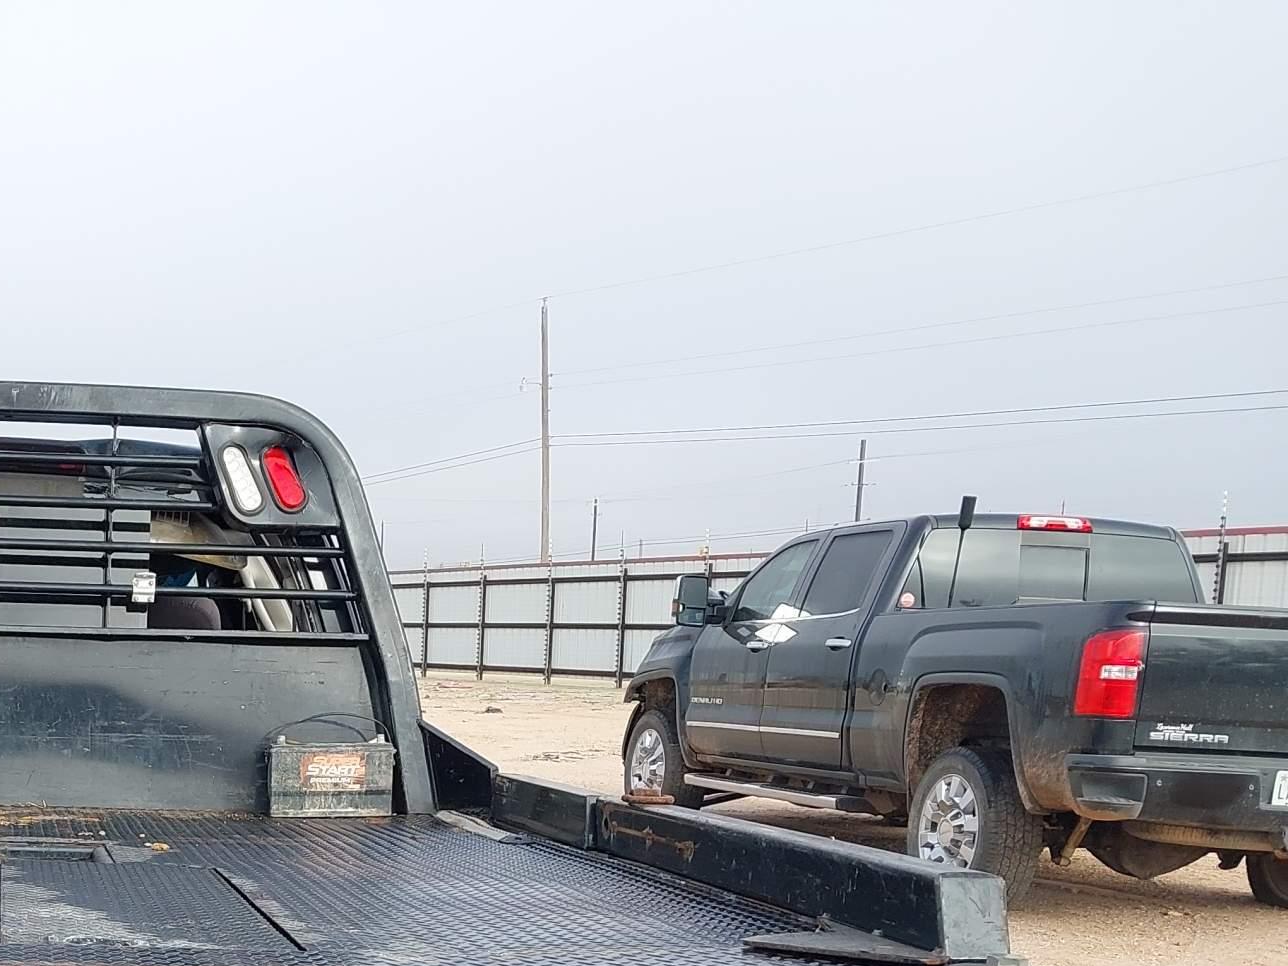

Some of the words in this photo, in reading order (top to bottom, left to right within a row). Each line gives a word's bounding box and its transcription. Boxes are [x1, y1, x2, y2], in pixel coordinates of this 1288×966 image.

[1149, 731, 1230, 744] SIERRA
[312, 755, 361, 766] SUPER
[305, 764, 357, 776] START
